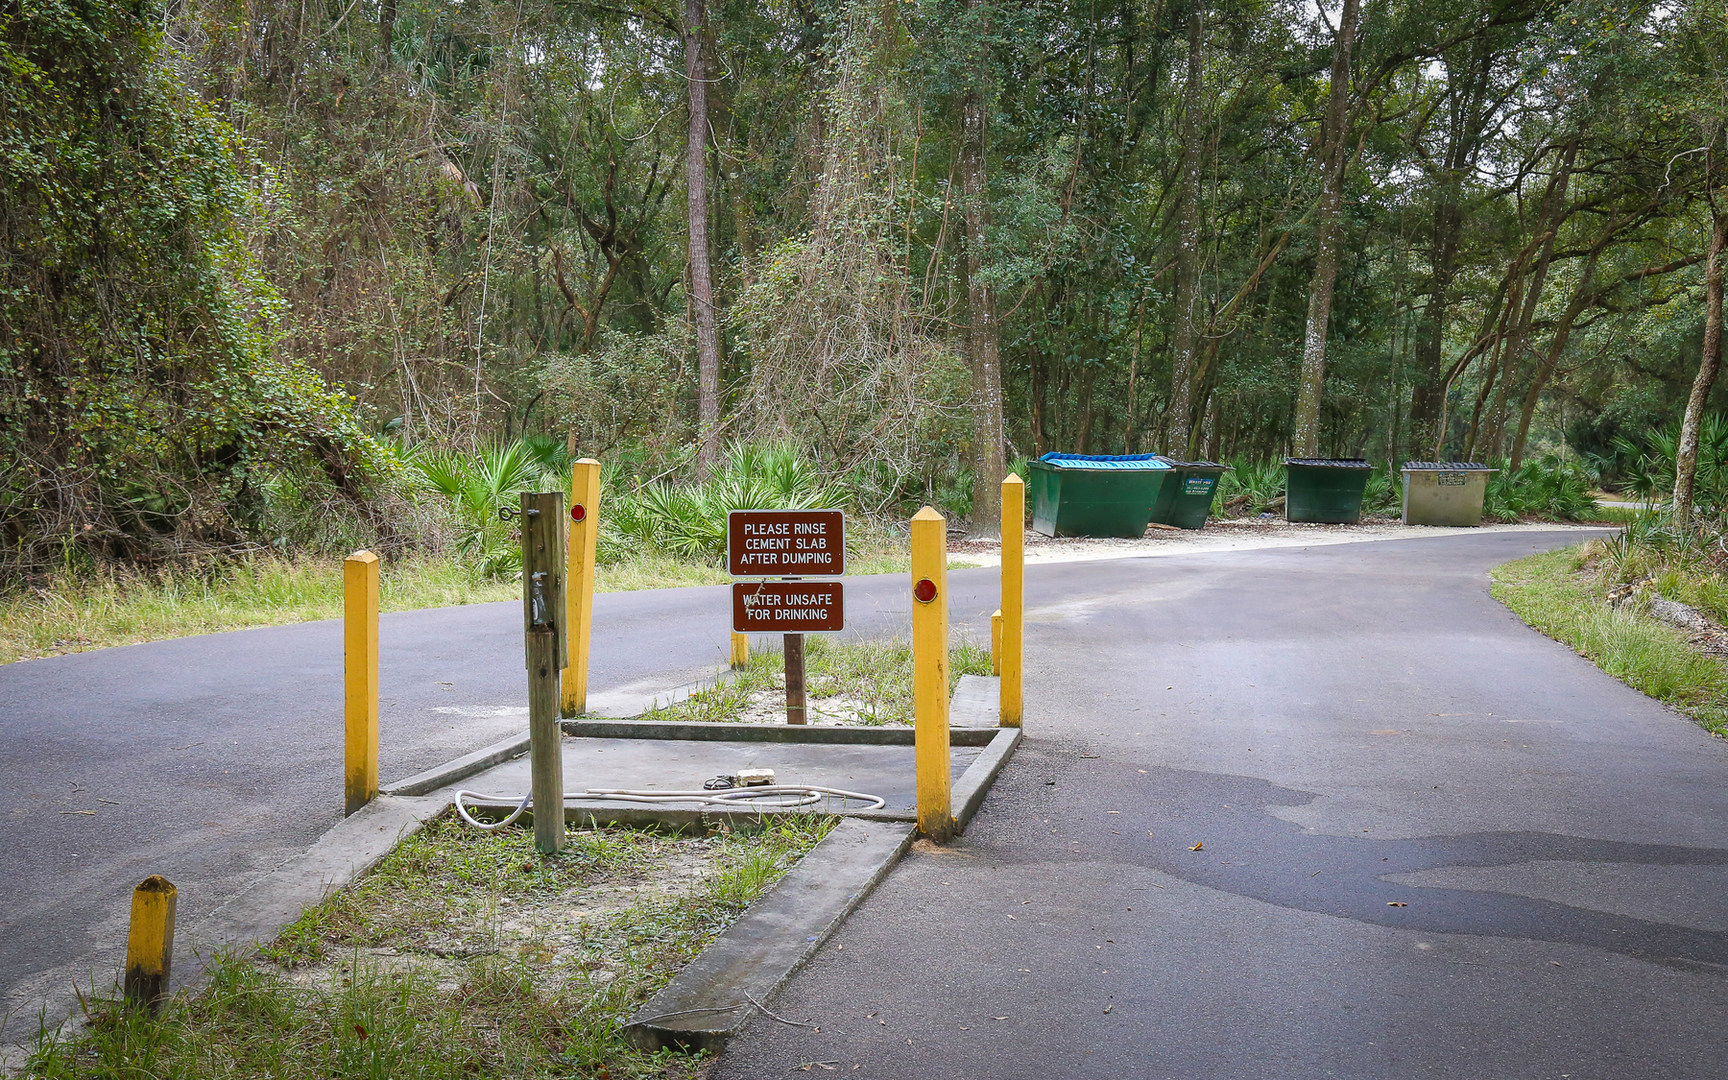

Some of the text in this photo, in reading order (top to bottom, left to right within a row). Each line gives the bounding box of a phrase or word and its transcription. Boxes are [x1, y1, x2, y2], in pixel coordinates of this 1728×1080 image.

[744, 523, 827, 535] PLEASE RINSE
[745, 538, 827, 550] CEMENT SLAB
[740, 553, 832, 565] AFTER DUMPING
[743, 594, 833, 606] WATER UNSAFE
[748, 608, 828, 620] FOR DRINKING
